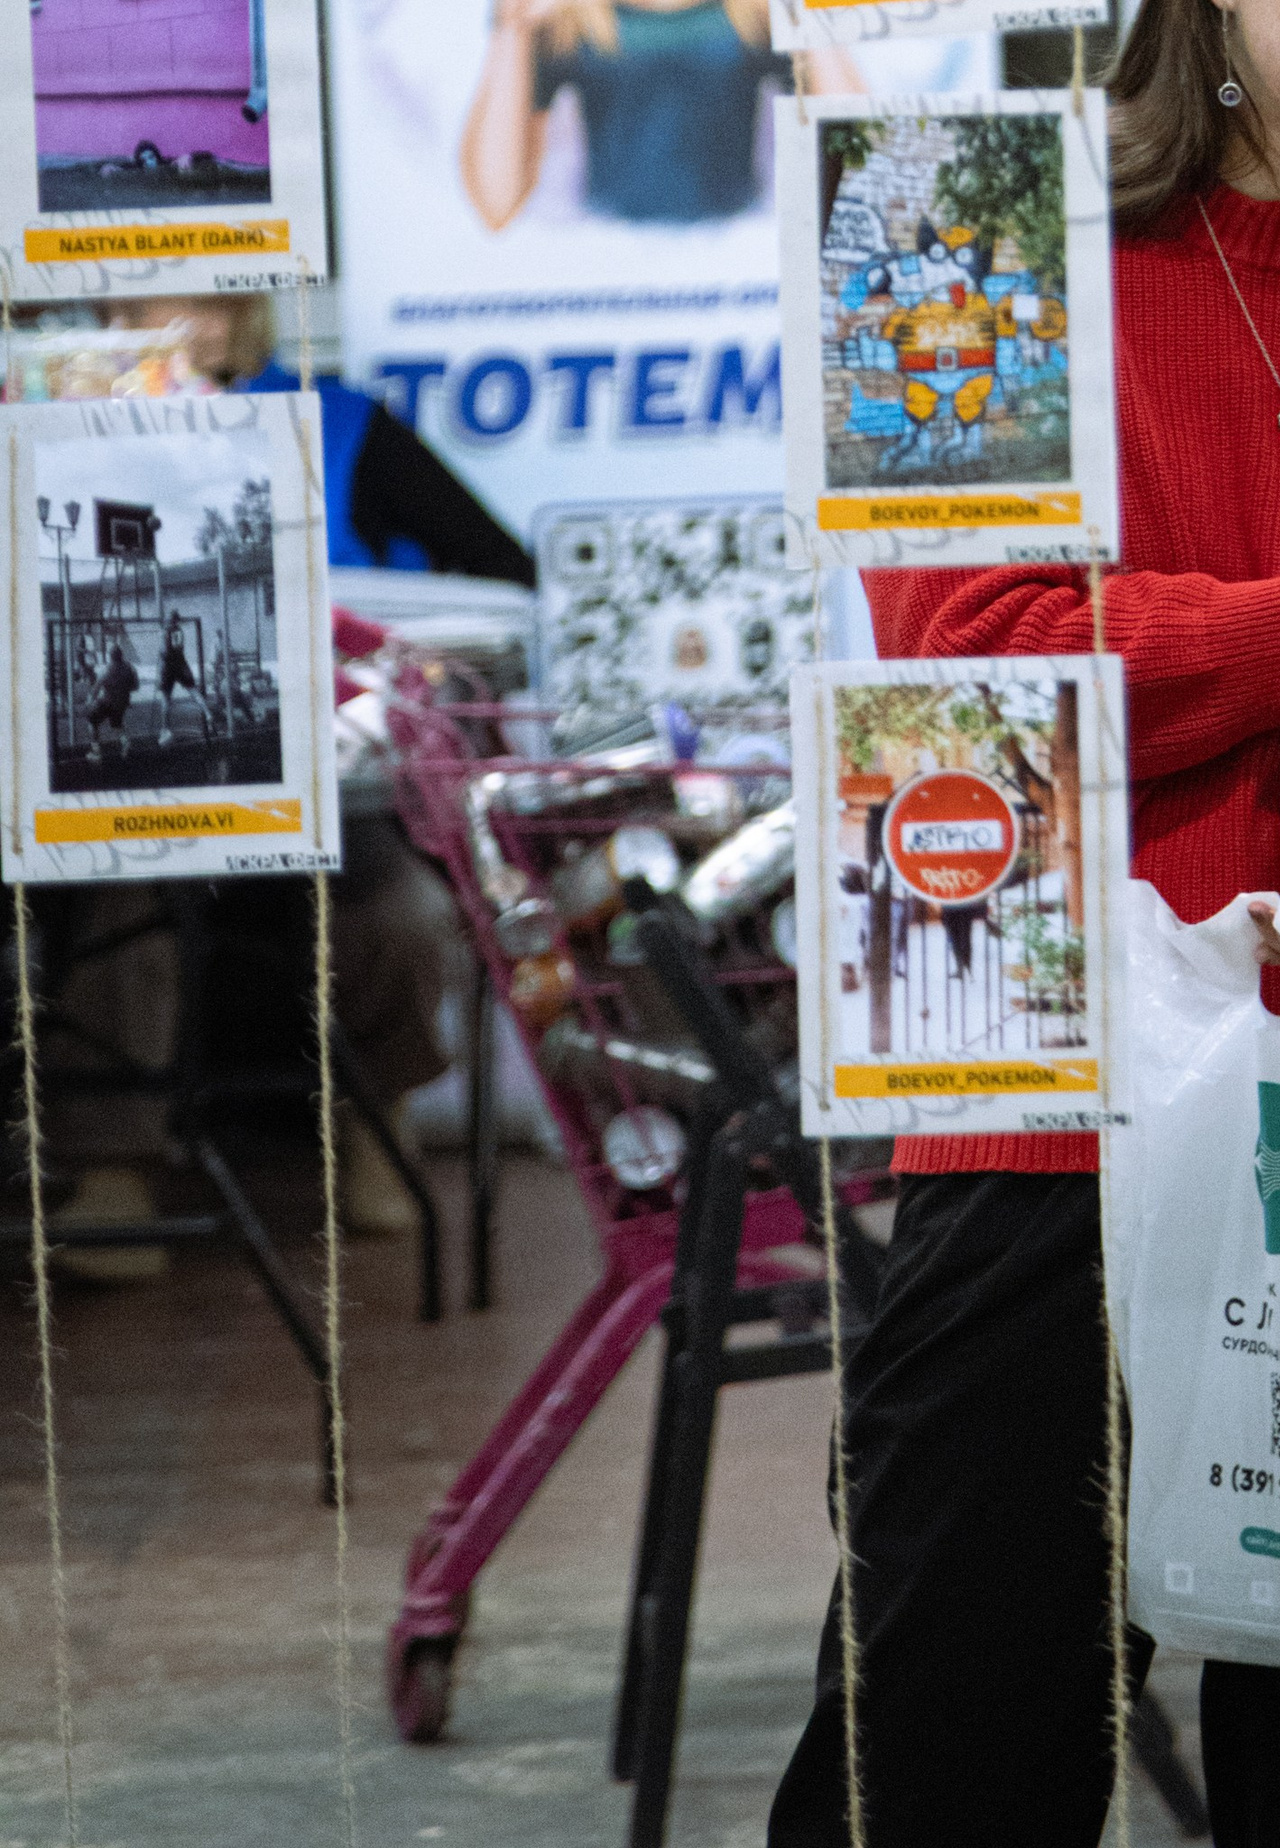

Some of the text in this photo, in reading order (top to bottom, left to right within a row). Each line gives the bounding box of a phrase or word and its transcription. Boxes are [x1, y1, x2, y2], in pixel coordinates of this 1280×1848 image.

[60, 229, 265, 253] NASTYA BLANT (DARK)
[869, 502, 1040, 523] BOEVOY_POKEMON
[113, 812, 234, 832] ROZHNOVA.VI
[886, 1069, 1056, 1090] BOEVOY_POKEMON
[1210, 1463, 1223, 1487] 8
